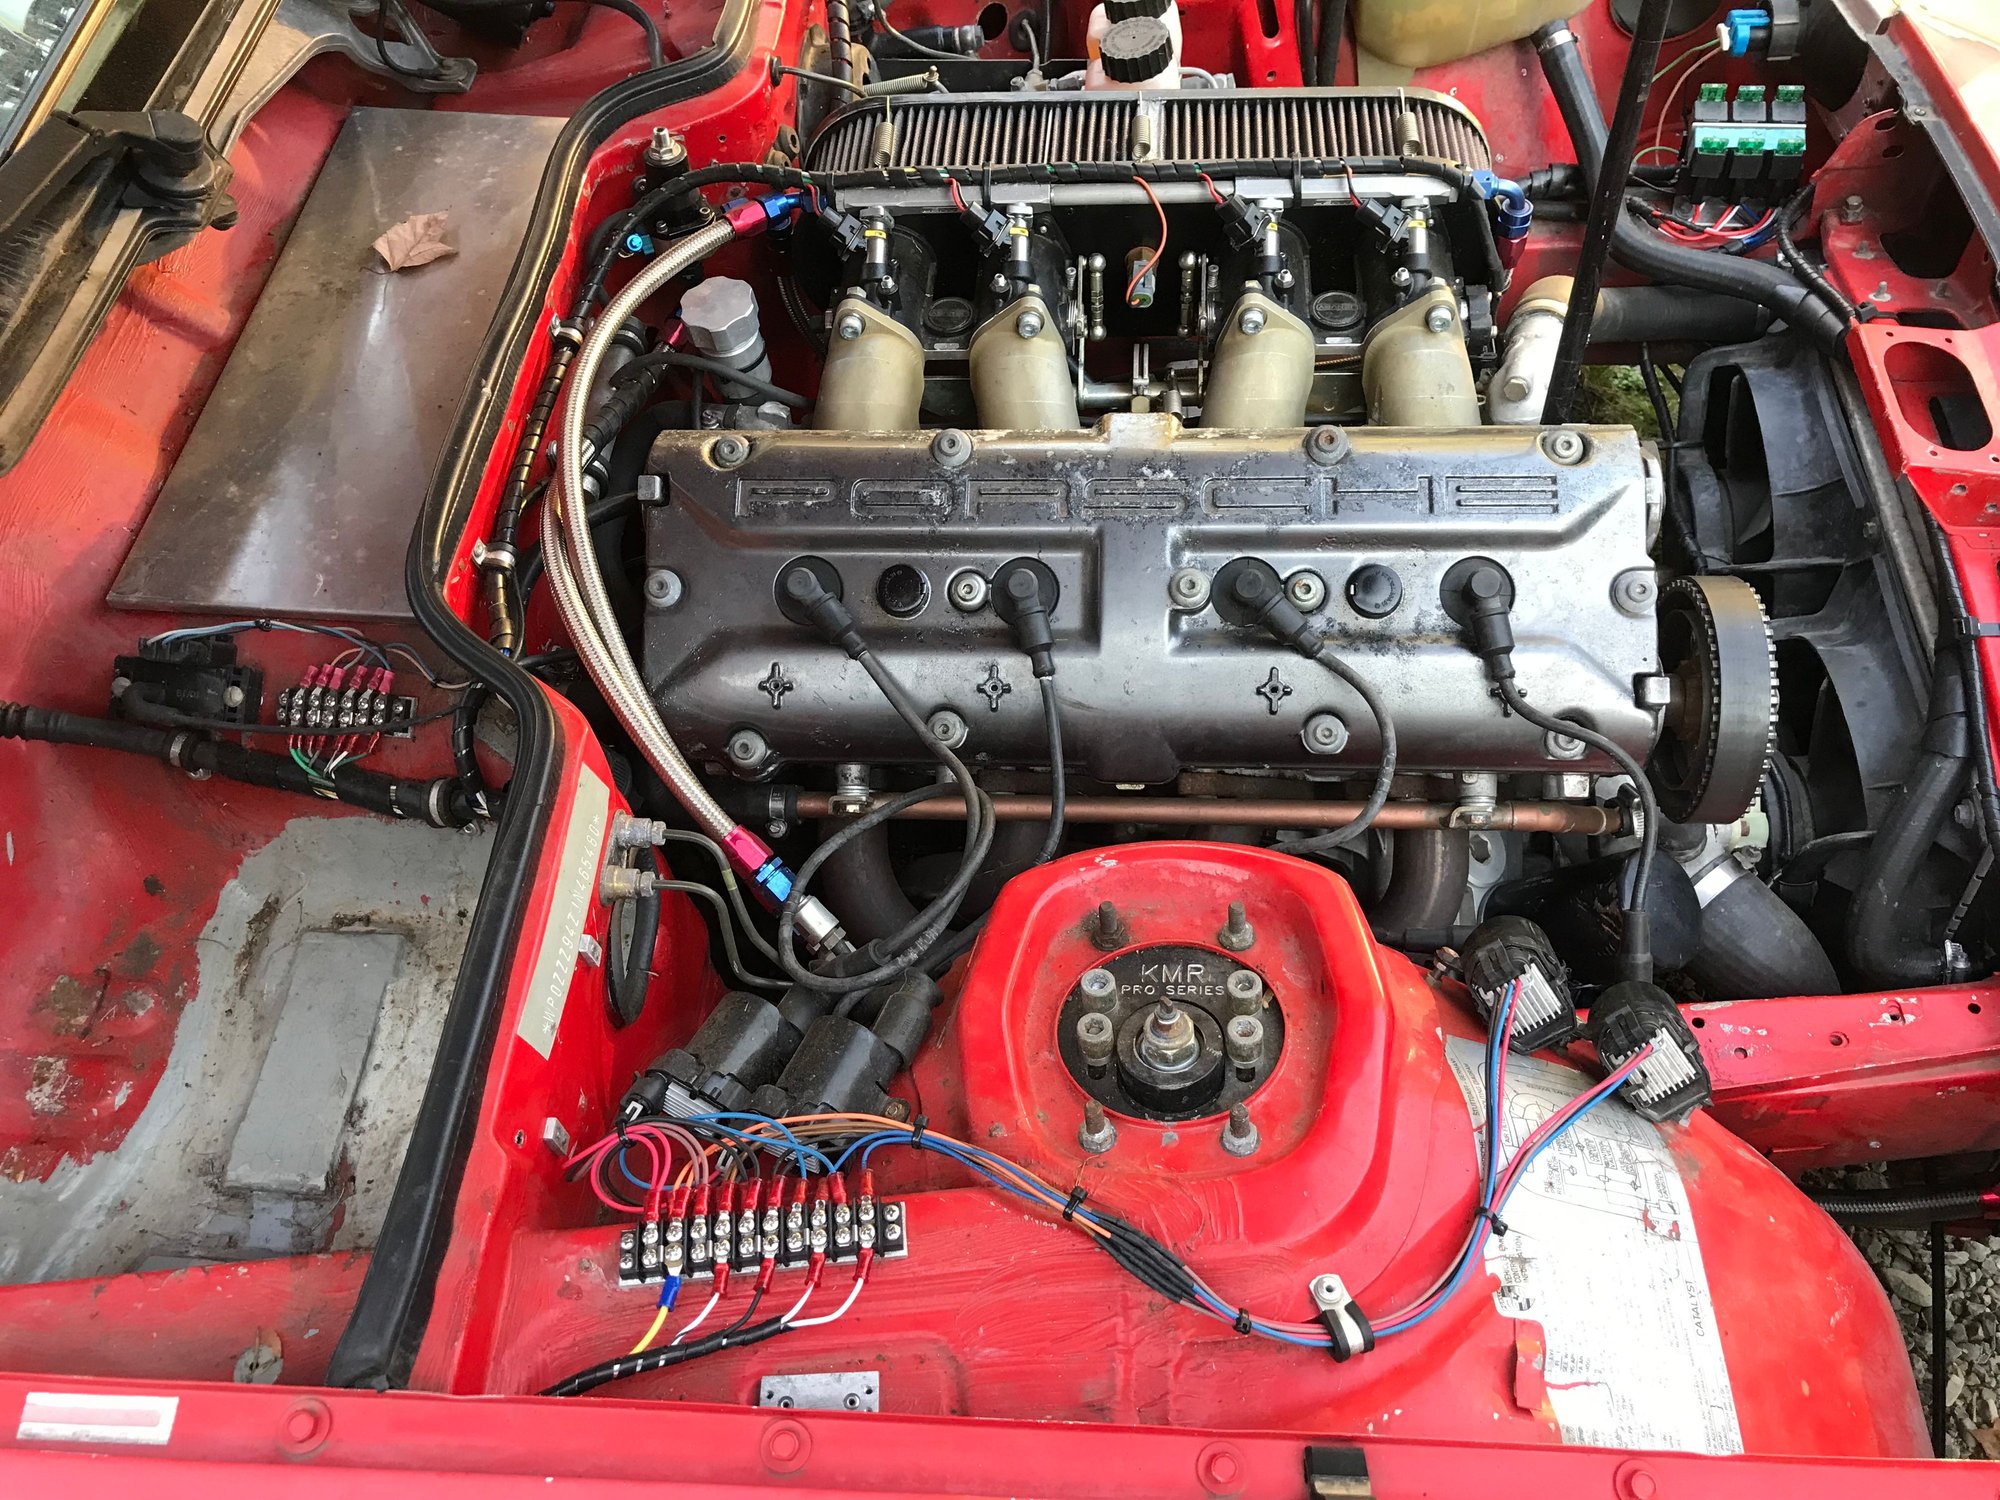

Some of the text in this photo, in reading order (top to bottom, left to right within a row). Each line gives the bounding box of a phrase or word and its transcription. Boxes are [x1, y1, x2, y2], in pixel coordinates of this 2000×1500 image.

[735, 475, 1558, 520] PORSCHE
[1140, 963, 1206, 983] KMR
[1121, 985, 1225, 996] PRO SERIES
[1685, 1280, 1704, 1337] CATALYST
